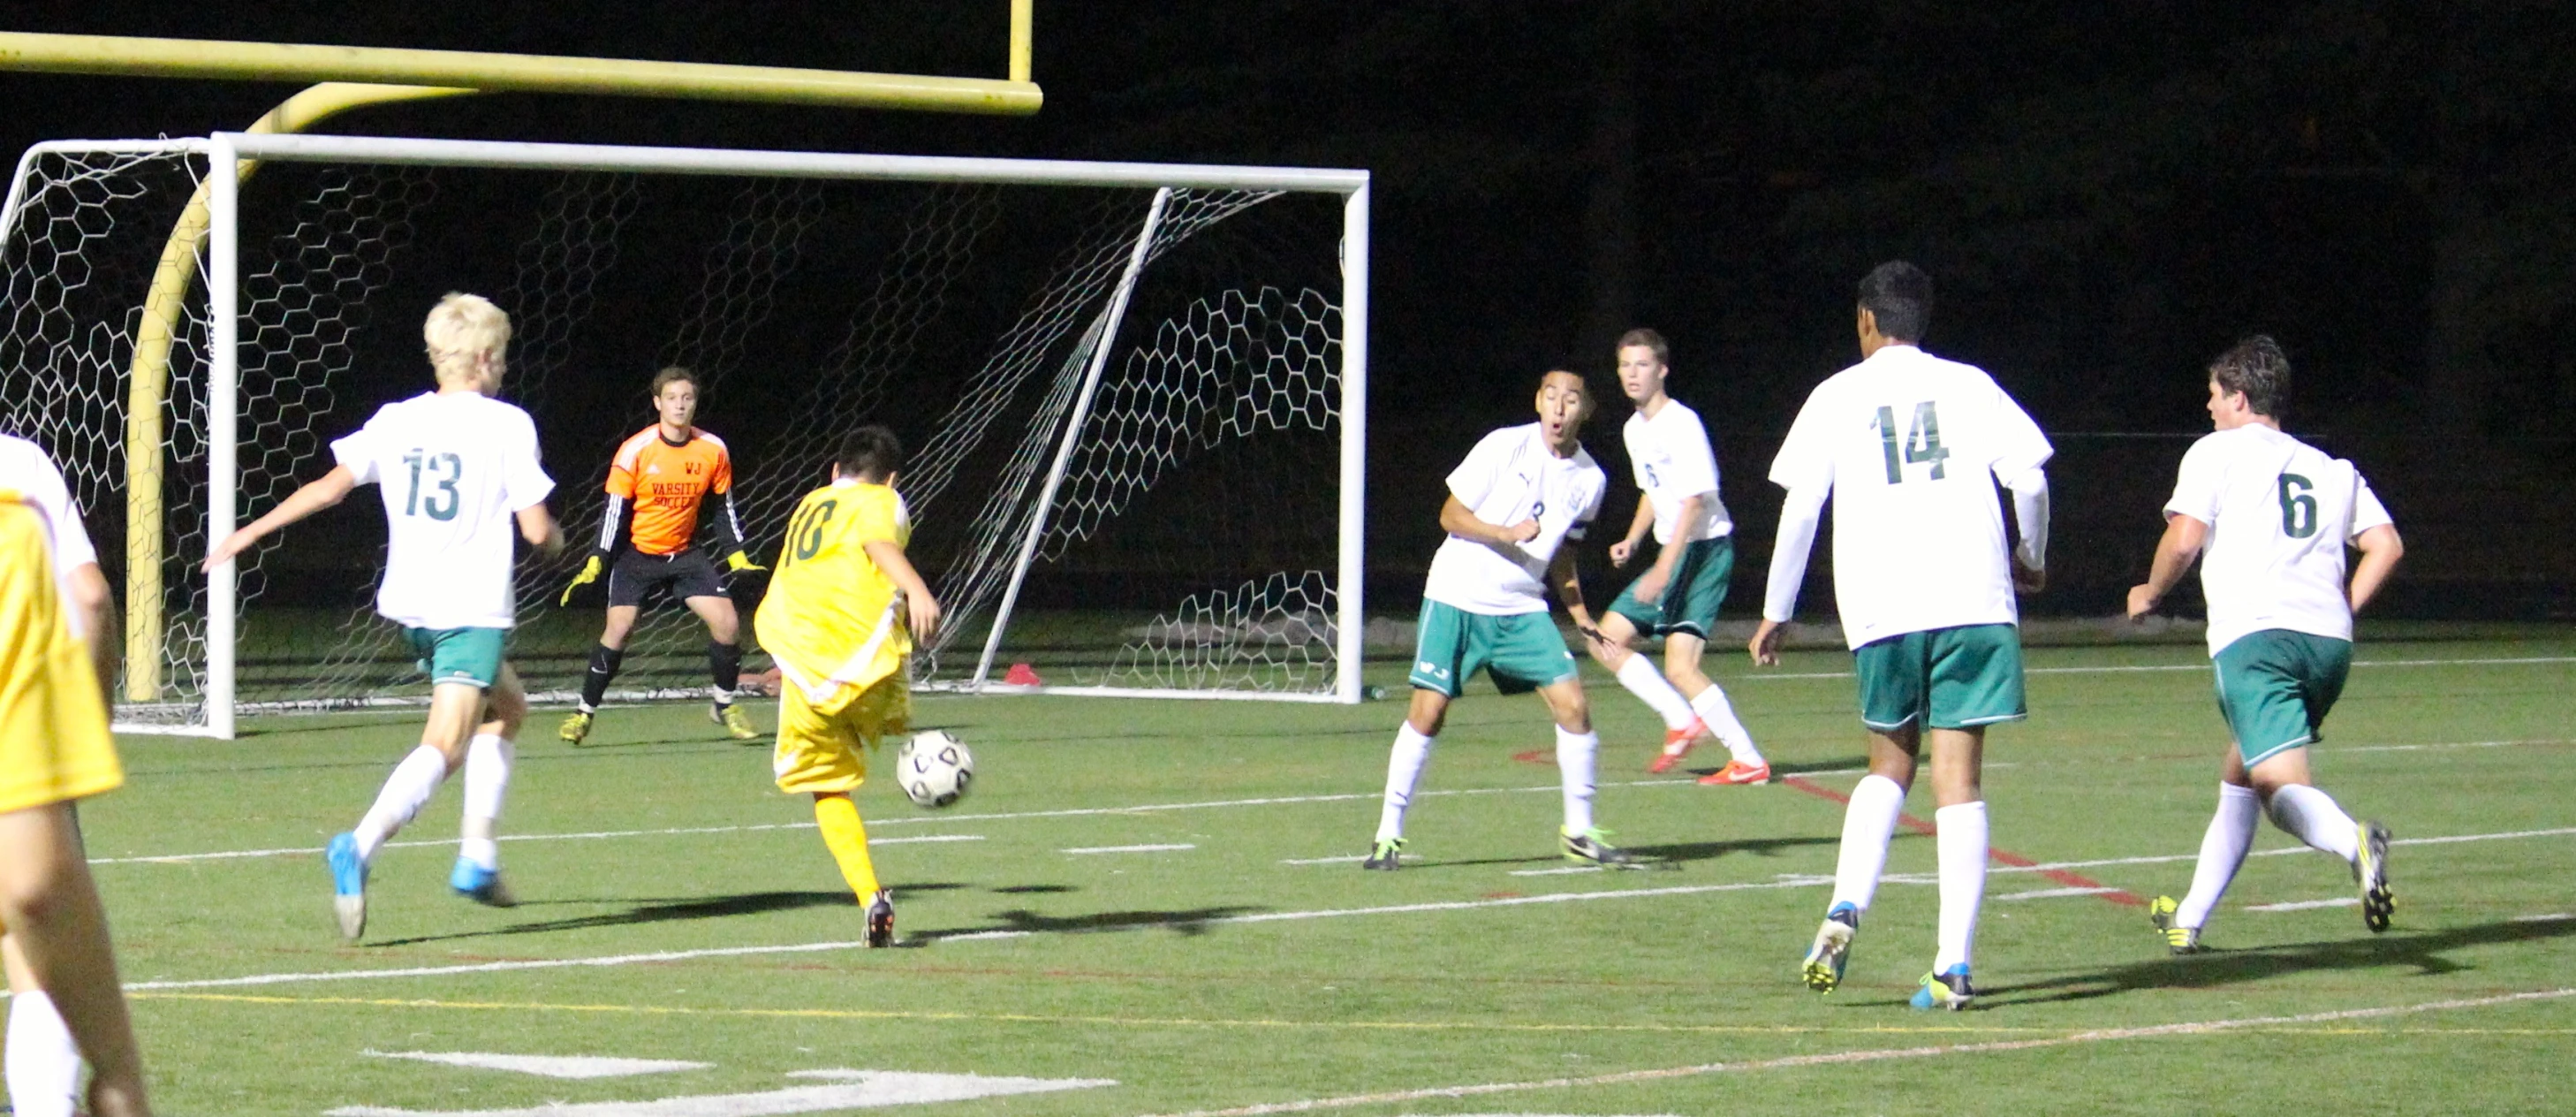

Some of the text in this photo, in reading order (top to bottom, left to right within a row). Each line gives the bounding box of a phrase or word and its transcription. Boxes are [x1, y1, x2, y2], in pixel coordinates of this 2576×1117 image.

[686, 462, 701, 475] WJ
[1869, 400, 1950, 484] 14
[403, 447, 461, 521] 13
[652, 483, 700, 495] VARSITY
[2277, 473, 2317, 539] 6
[784, 499, 837, 568] 10
